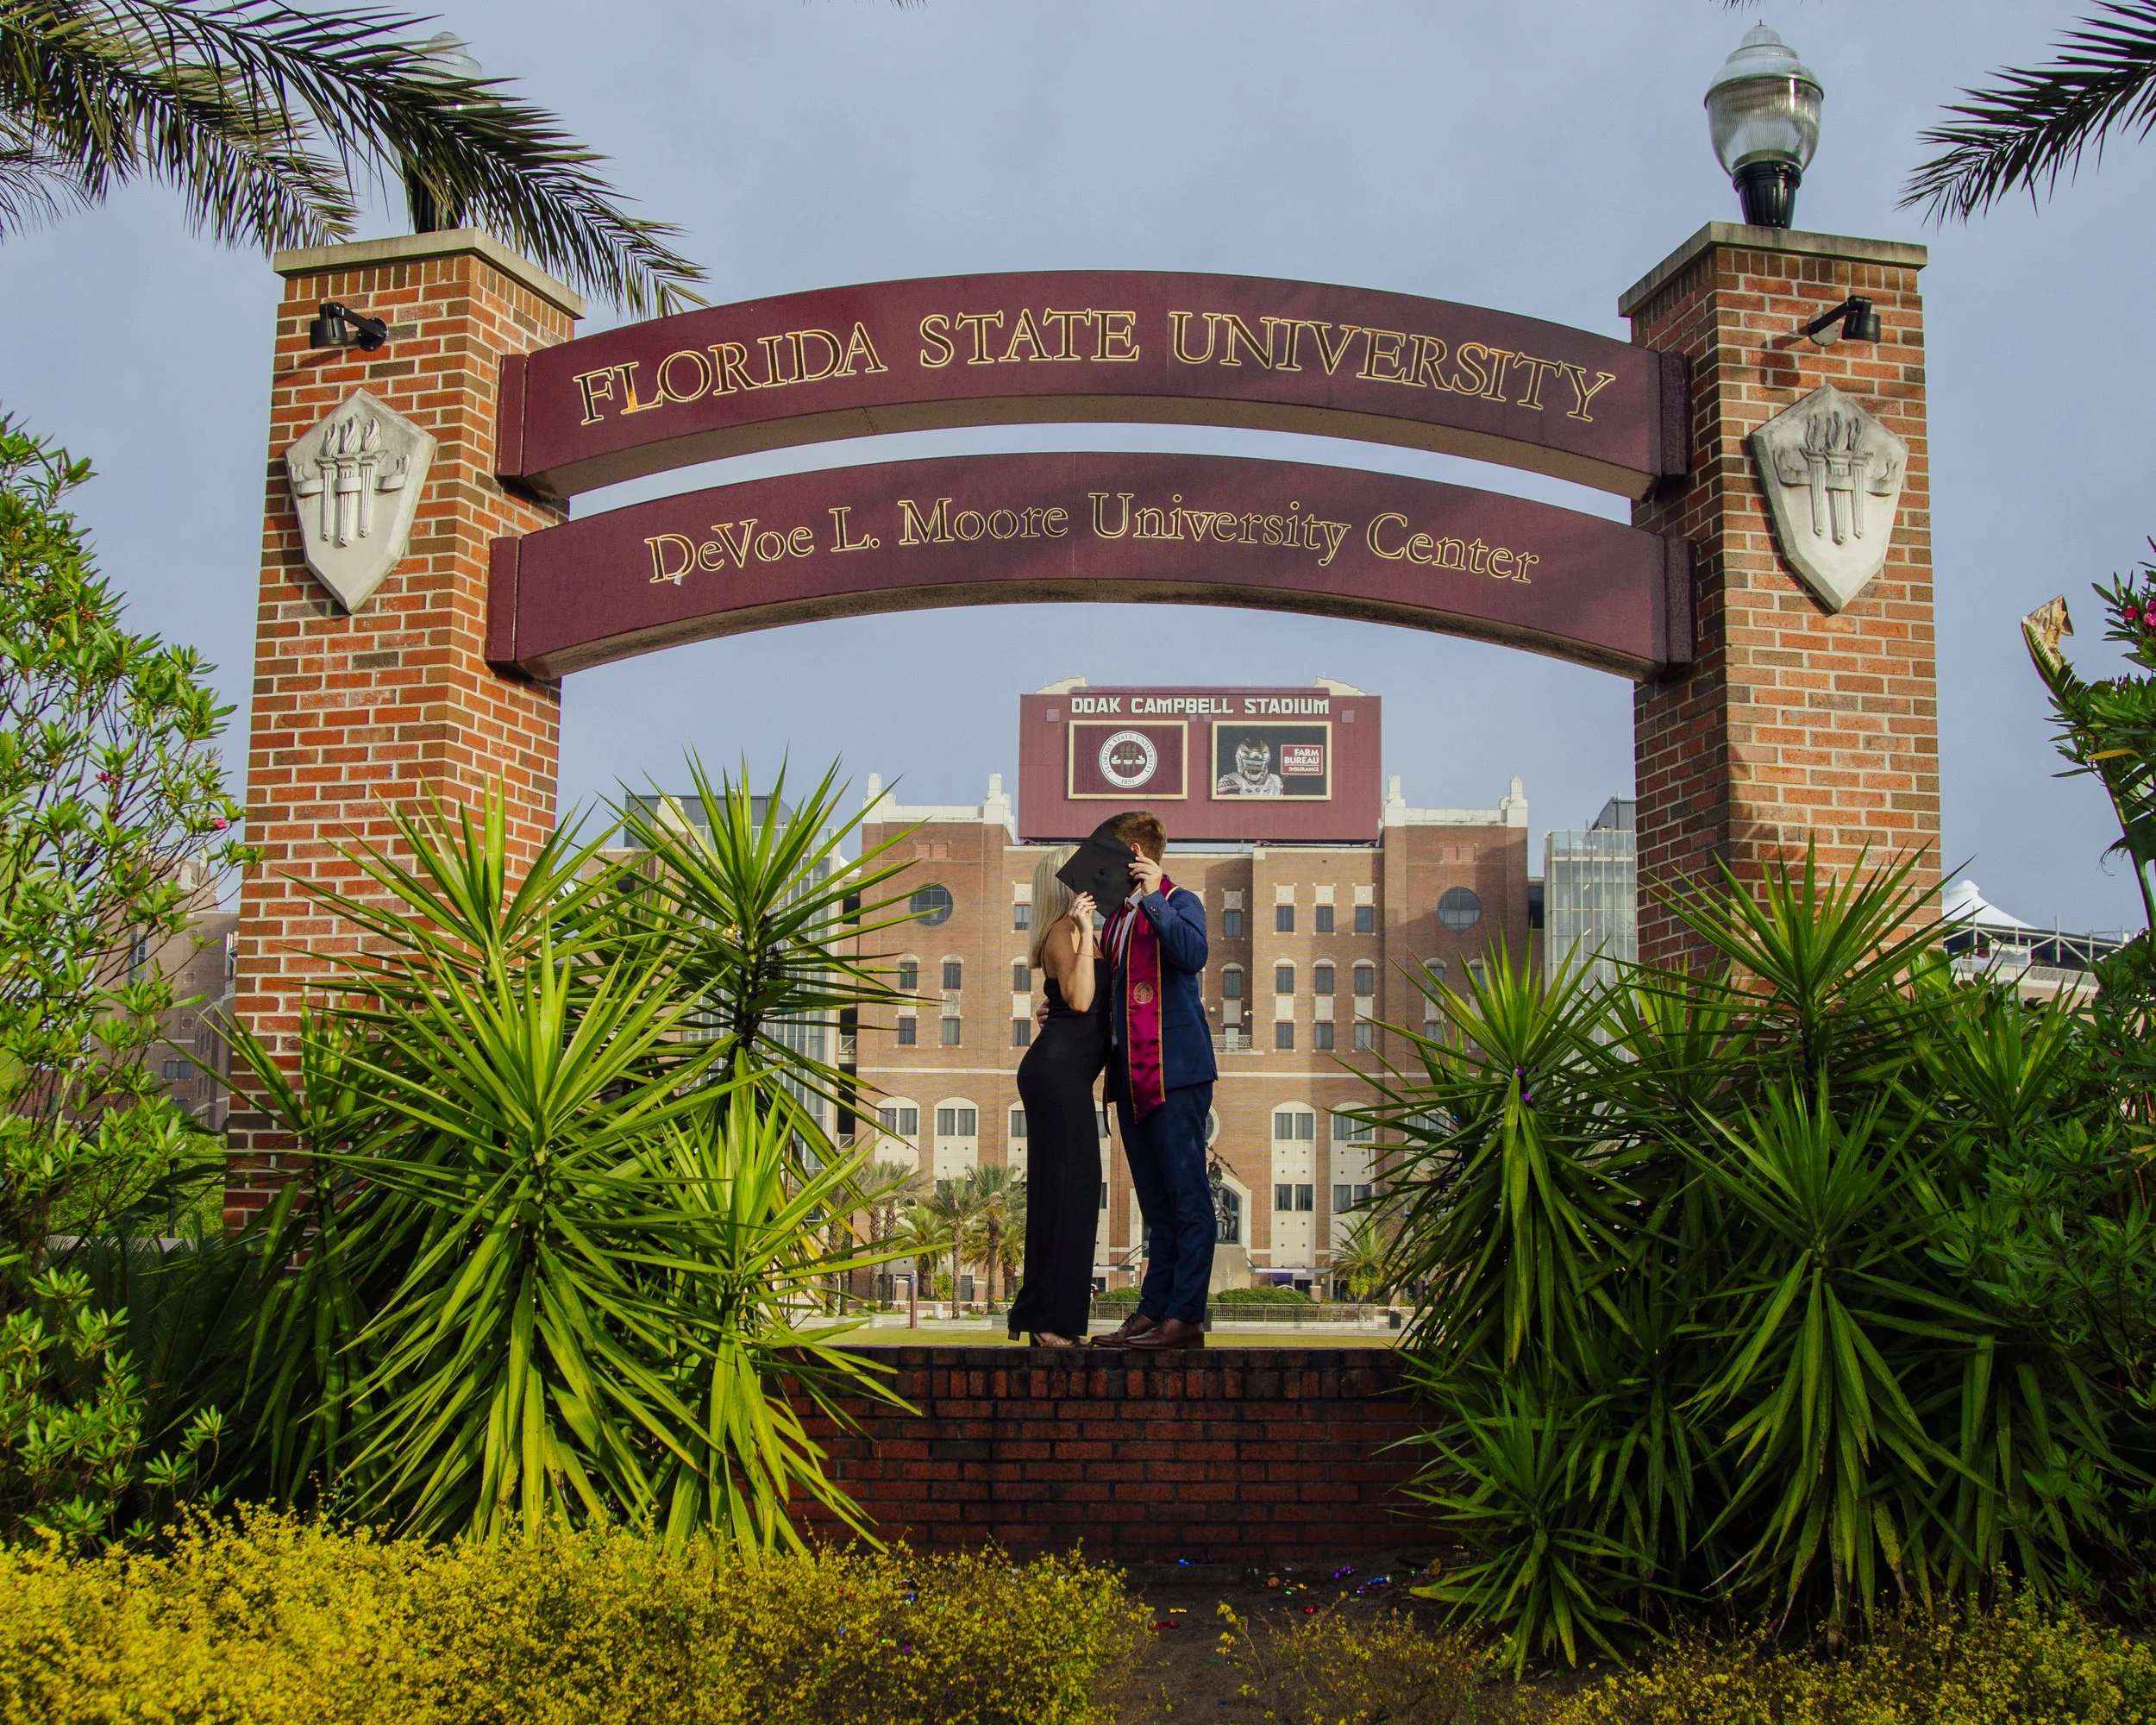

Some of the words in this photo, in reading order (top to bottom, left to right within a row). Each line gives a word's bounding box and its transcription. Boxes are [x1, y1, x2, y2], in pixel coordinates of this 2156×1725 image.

[572, 321, 888, 425] FLORIDA
[919, 308, 1140, 368] STATE
[1168, 310, 1616, 423] UNIVERSITY
[644, 518, 814, 584] DeVoe
[829, 506, 881, 552] L.
[897, 497, 1069, 546] Moore
[1088, 492, 1351, 567] University
[1366, 512, 1539, 584] Center
[1071, 697, 1121, 713] DOAK
[1131, 698, 1234, 714] CAMPBELL
[1244, 698, 1330, 714] STADIUM
[1103, 743, 1113, 774] FLORIDA
[1112, 734, 1132, 743] STATE
[1136, 736, 1154, 773] UNIVERSITY
